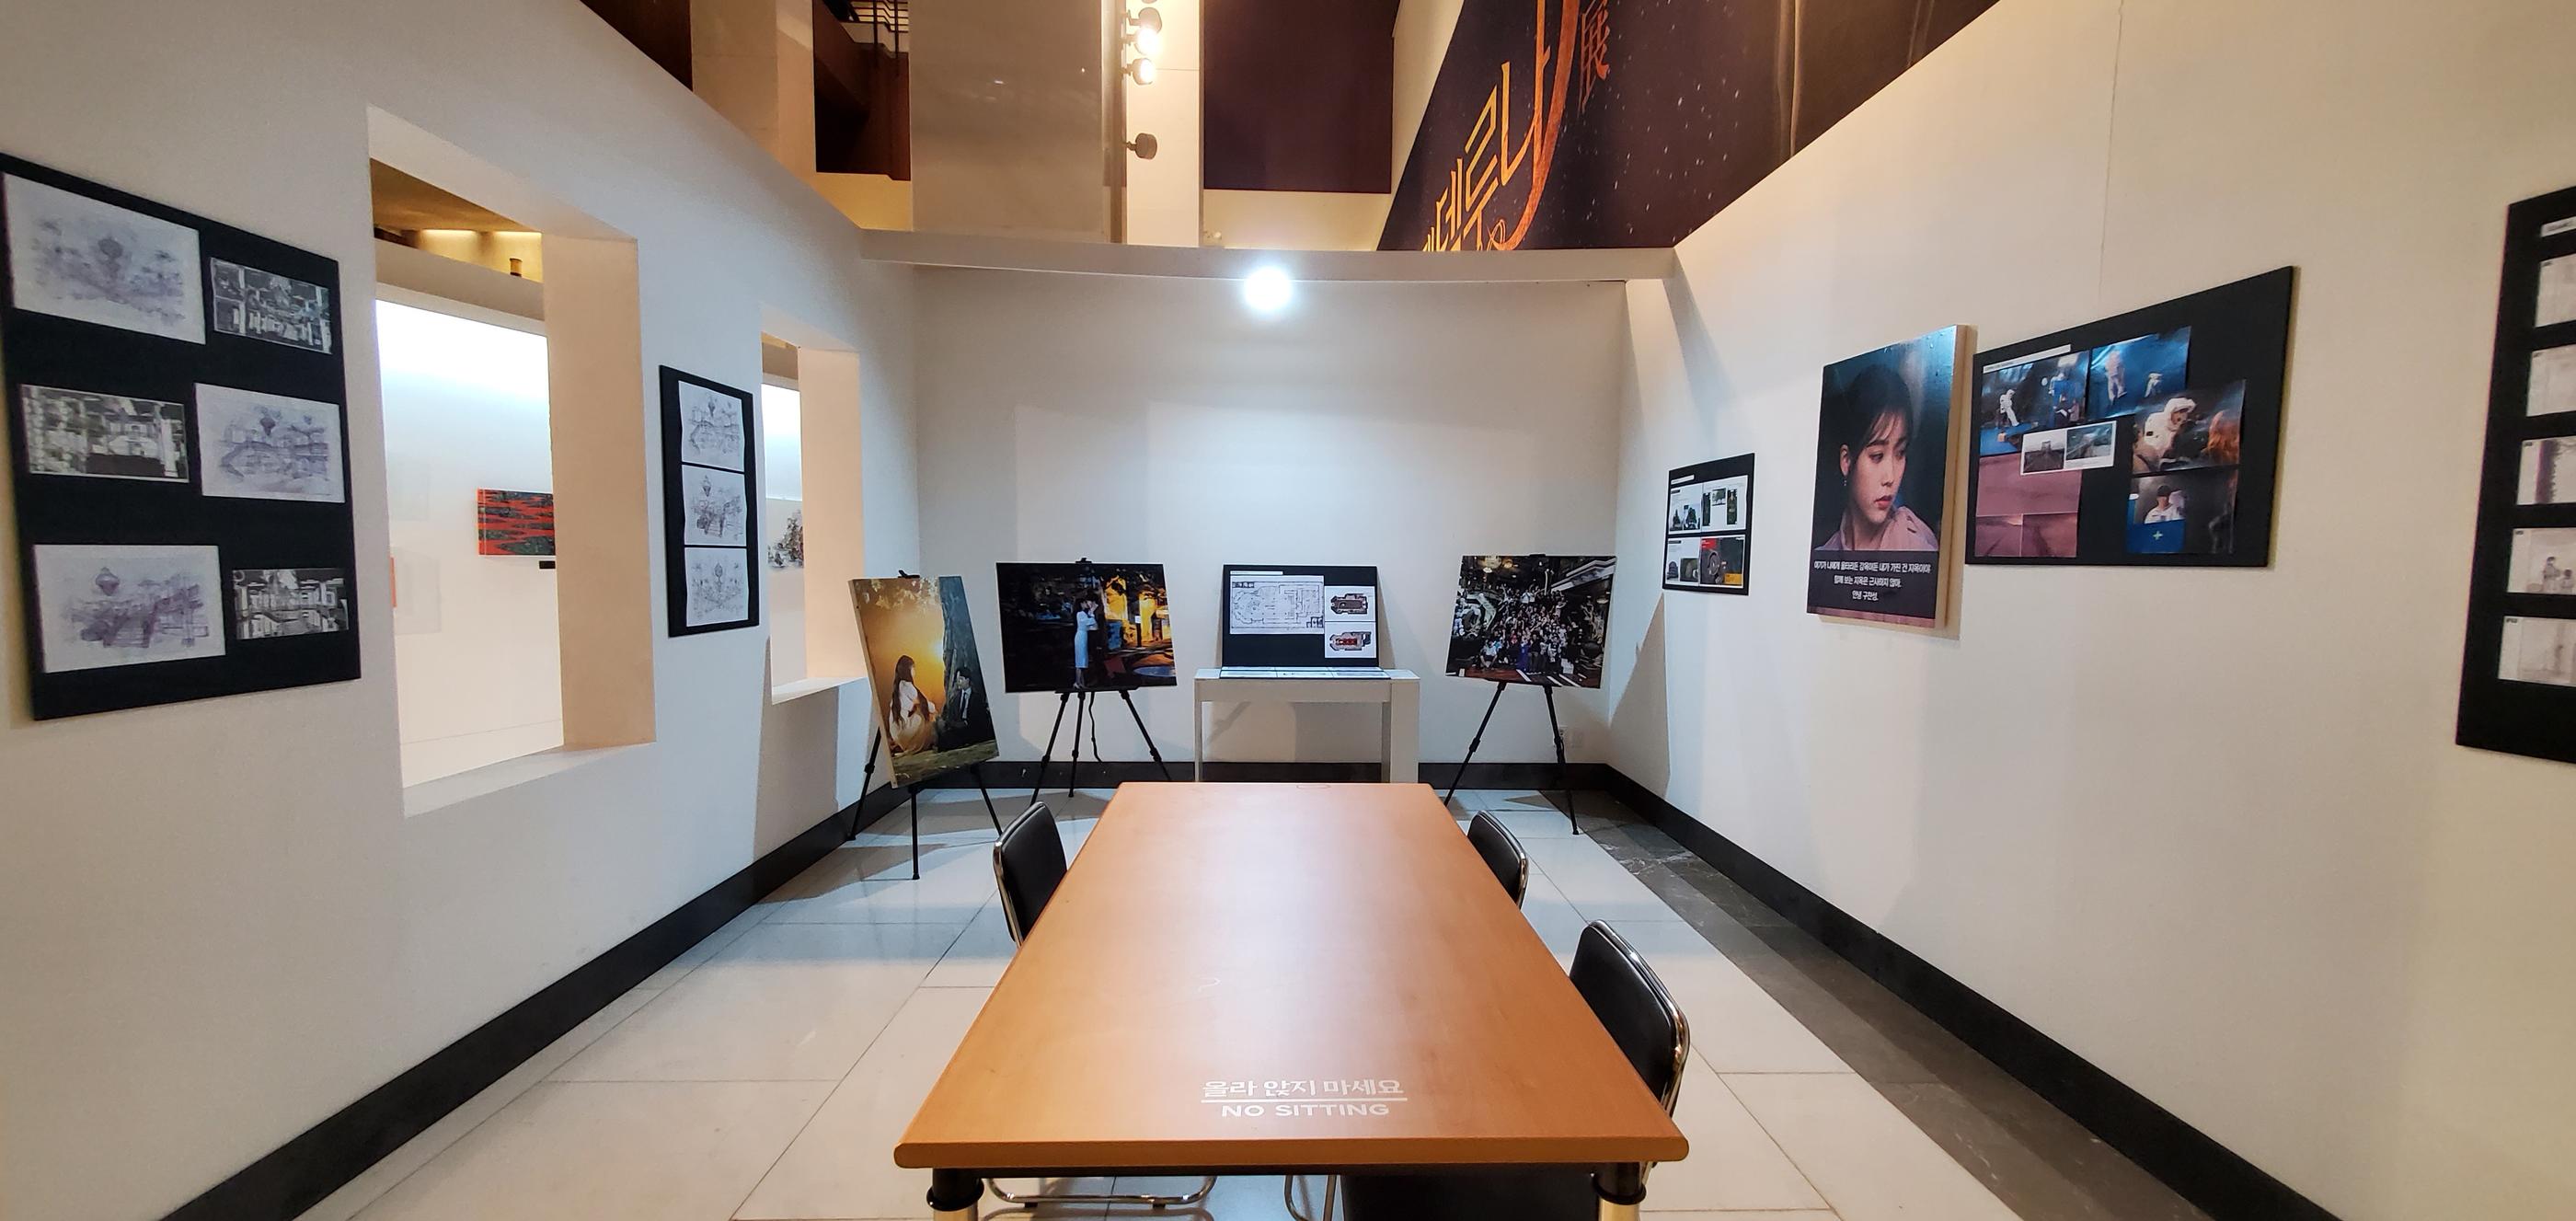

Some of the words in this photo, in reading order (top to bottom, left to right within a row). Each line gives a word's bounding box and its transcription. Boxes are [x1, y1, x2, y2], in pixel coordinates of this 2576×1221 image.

[1202, 1079, 1258, 1098] 올라
[1264, 1079, 1317, 1097] 앉지
[1323, 1079, 1405, 1096] 마세요
[1221, 1104, 1264, 1117] NO
[1275, 1103, 1390, 1116] SITTING
